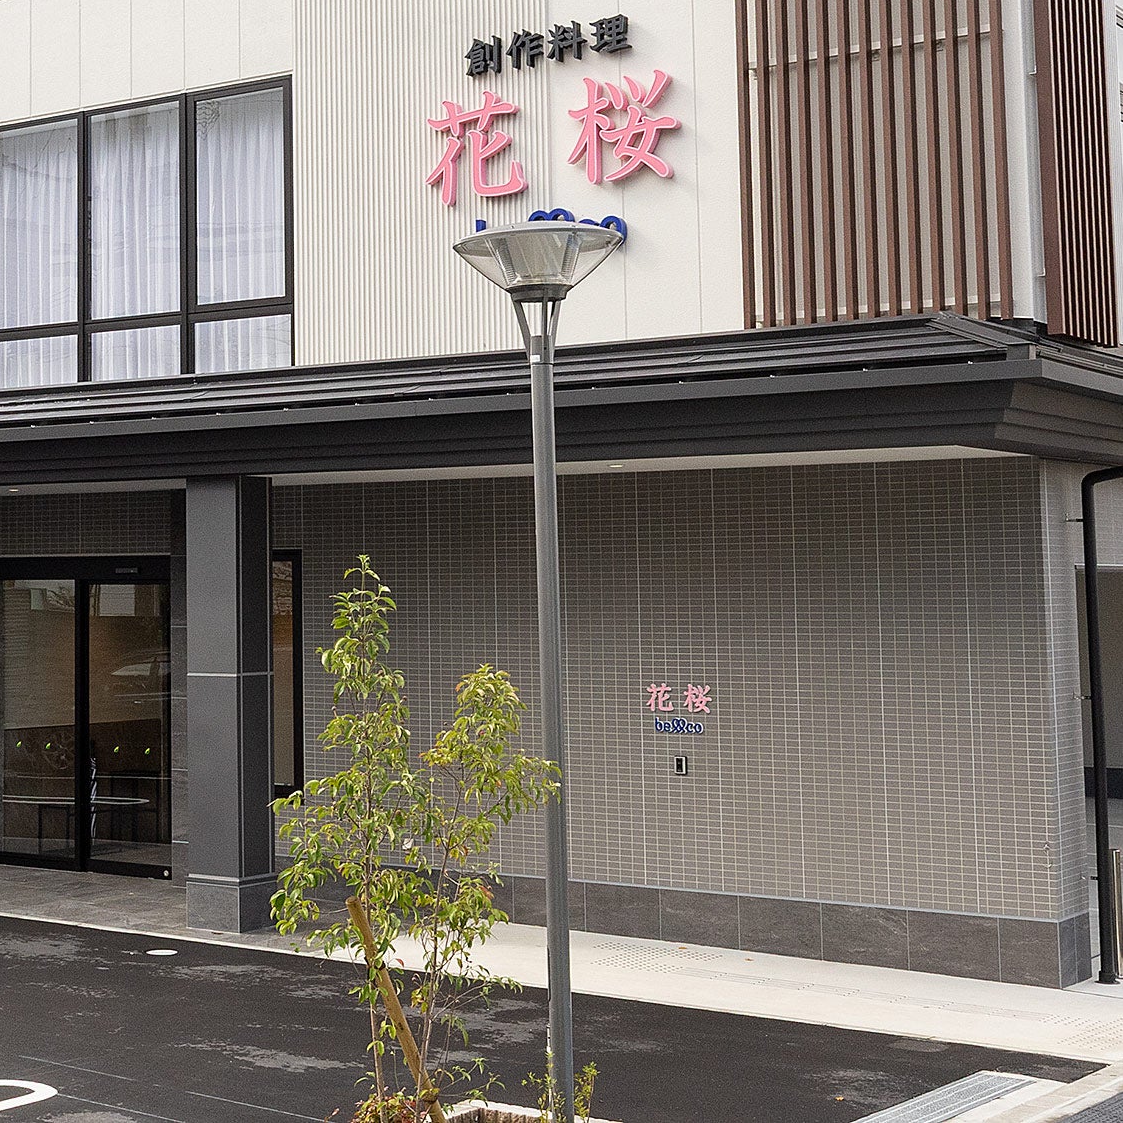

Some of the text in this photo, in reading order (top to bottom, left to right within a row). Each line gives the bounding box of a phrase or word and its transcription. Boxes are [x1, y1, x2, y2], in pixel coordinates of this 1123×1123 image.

[464, 13, 633, 77] 創作料理
[425, 69, 682, 206] 花桜
[646, 683, 712, 713] 花桜
